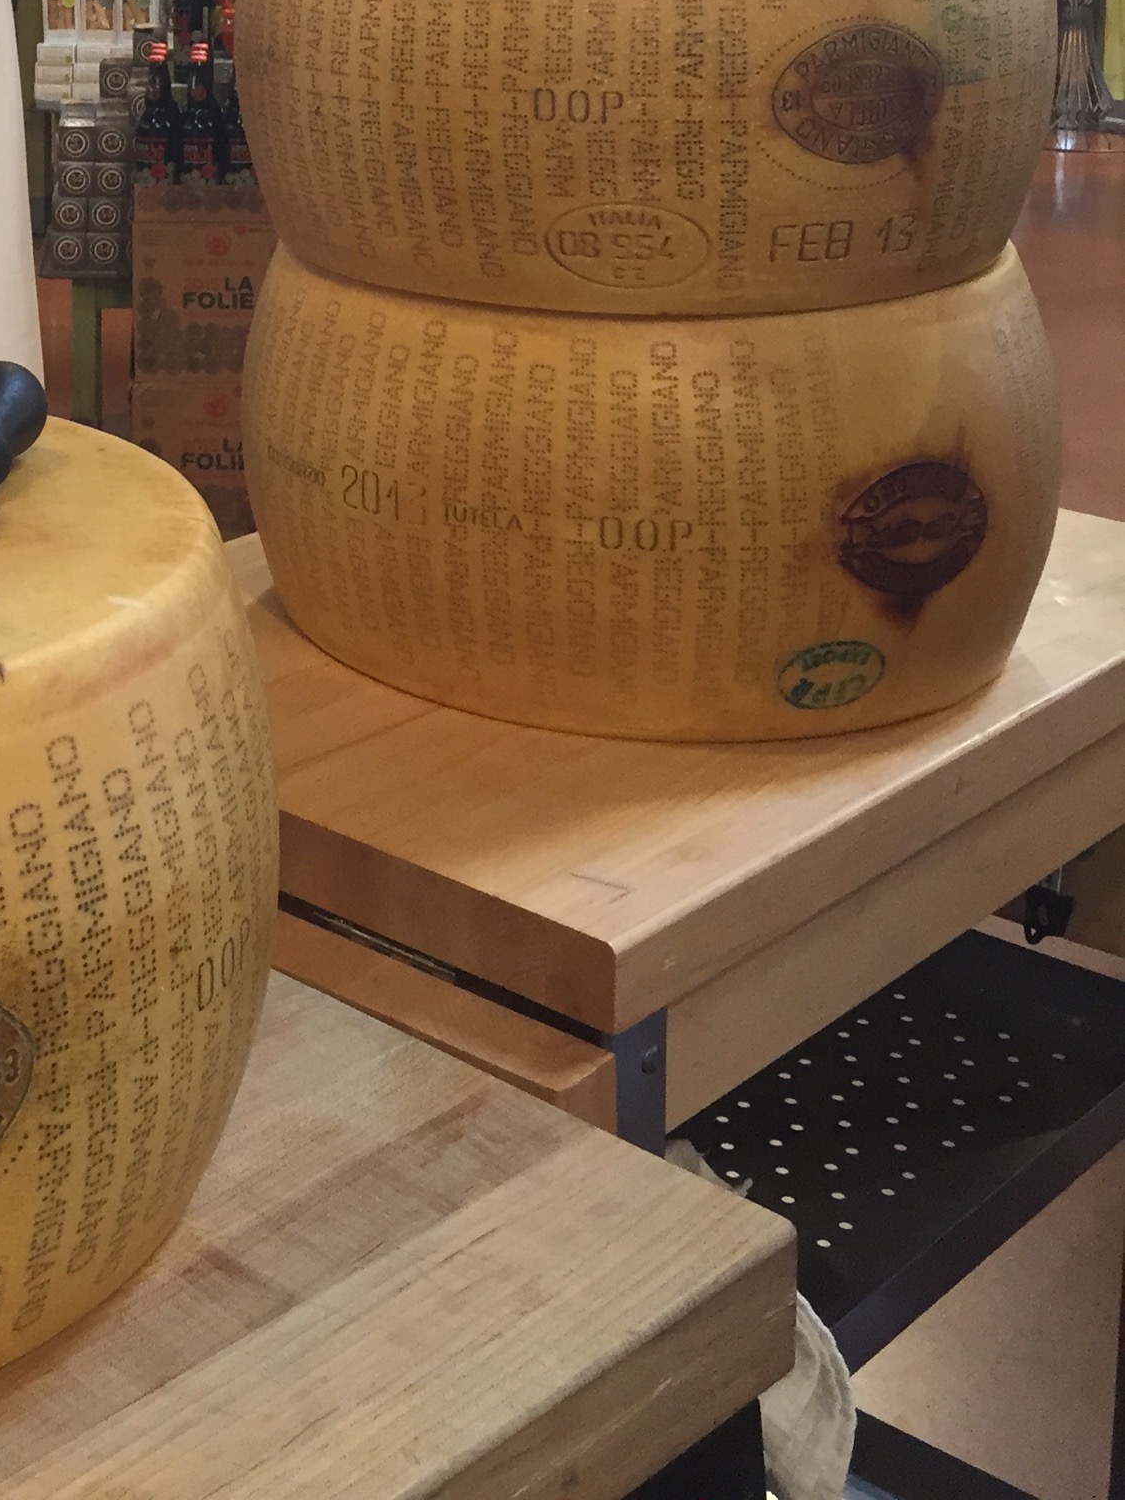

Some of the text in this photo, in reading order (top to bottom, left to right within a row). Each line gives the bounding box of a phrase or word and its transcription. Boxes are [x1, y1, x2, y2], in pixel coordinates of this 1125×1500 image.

[587, 210, 662, 230] ITALIA
[768, 212, 918, 263] FEB 13
[182, 291, 255, 310] FOLIE
[225, 276, 253, 291] LA
[346, 311, 387, 464] ARMIGIANO
[374, 344, 411, 469] EGGIANO
[406, 319, 448, 477] ARMIGIANO
[649, 340, 683, 506] ARMIGIANO
